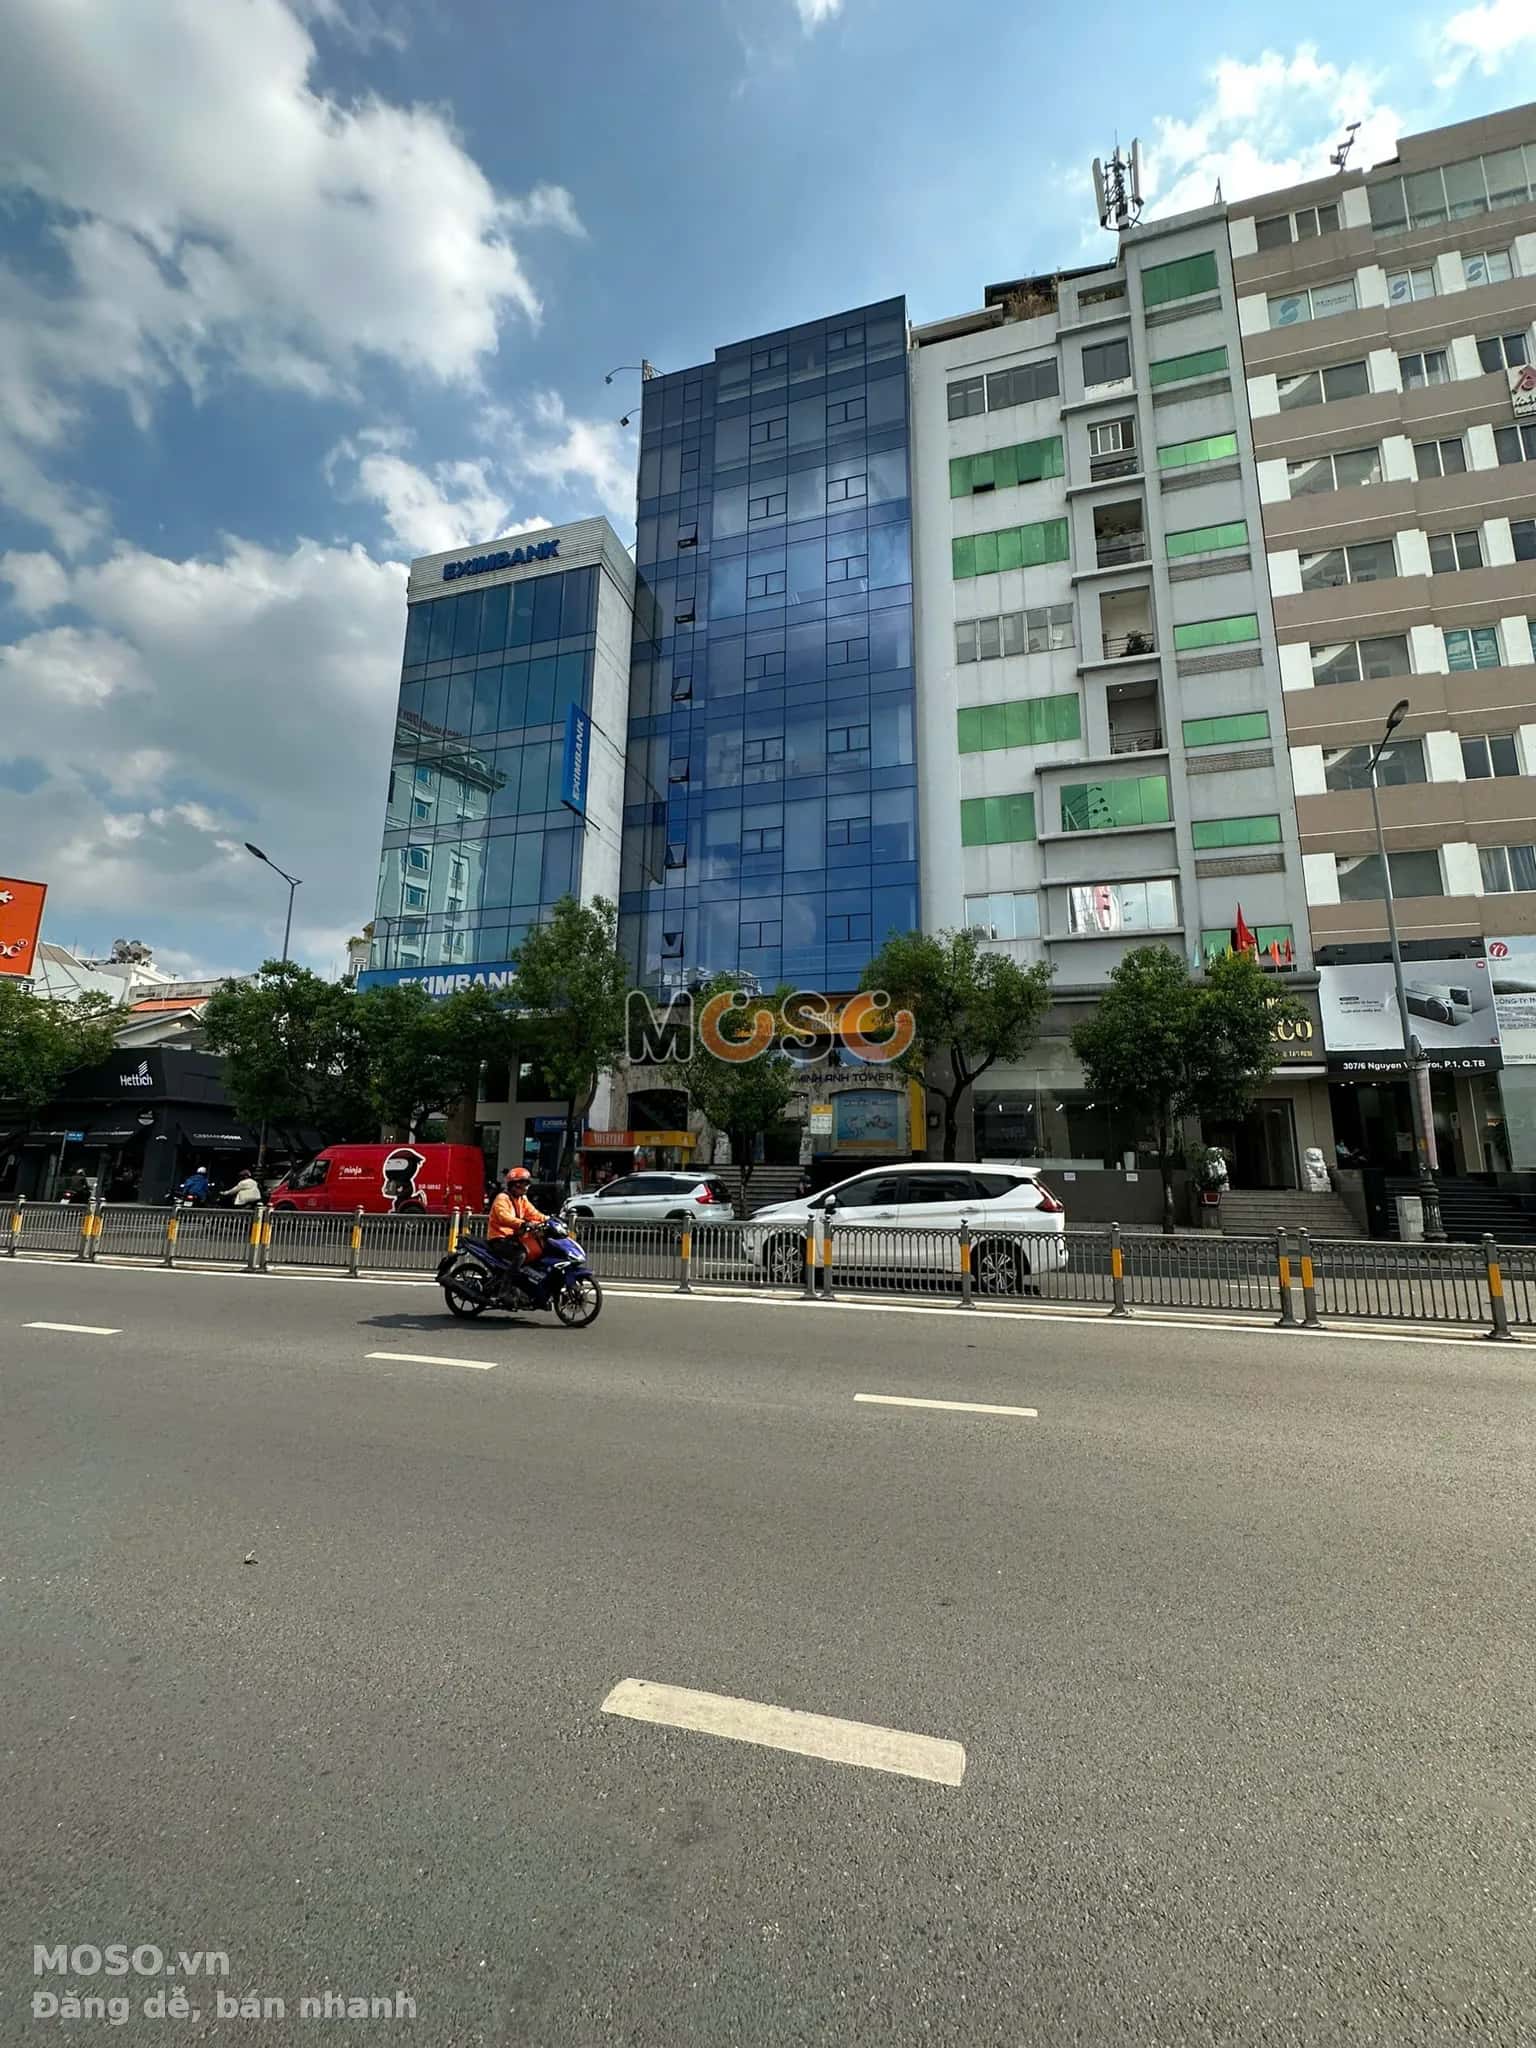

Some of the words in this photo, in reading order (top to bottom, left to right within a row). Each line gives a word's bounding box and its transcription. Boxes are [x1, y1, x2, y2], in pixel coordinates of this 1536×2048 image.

[443, 539, 560, 581] EXIMBANK
[572, 717, 584, 801] EXIMBANK
[1343, 1062, 1366, 1070] 307/6
[119, 1074, 153, 1087] Hettich
[852, 1072, 894, 1082] TOWER
[343, 1165, 362, 1176] ninja
